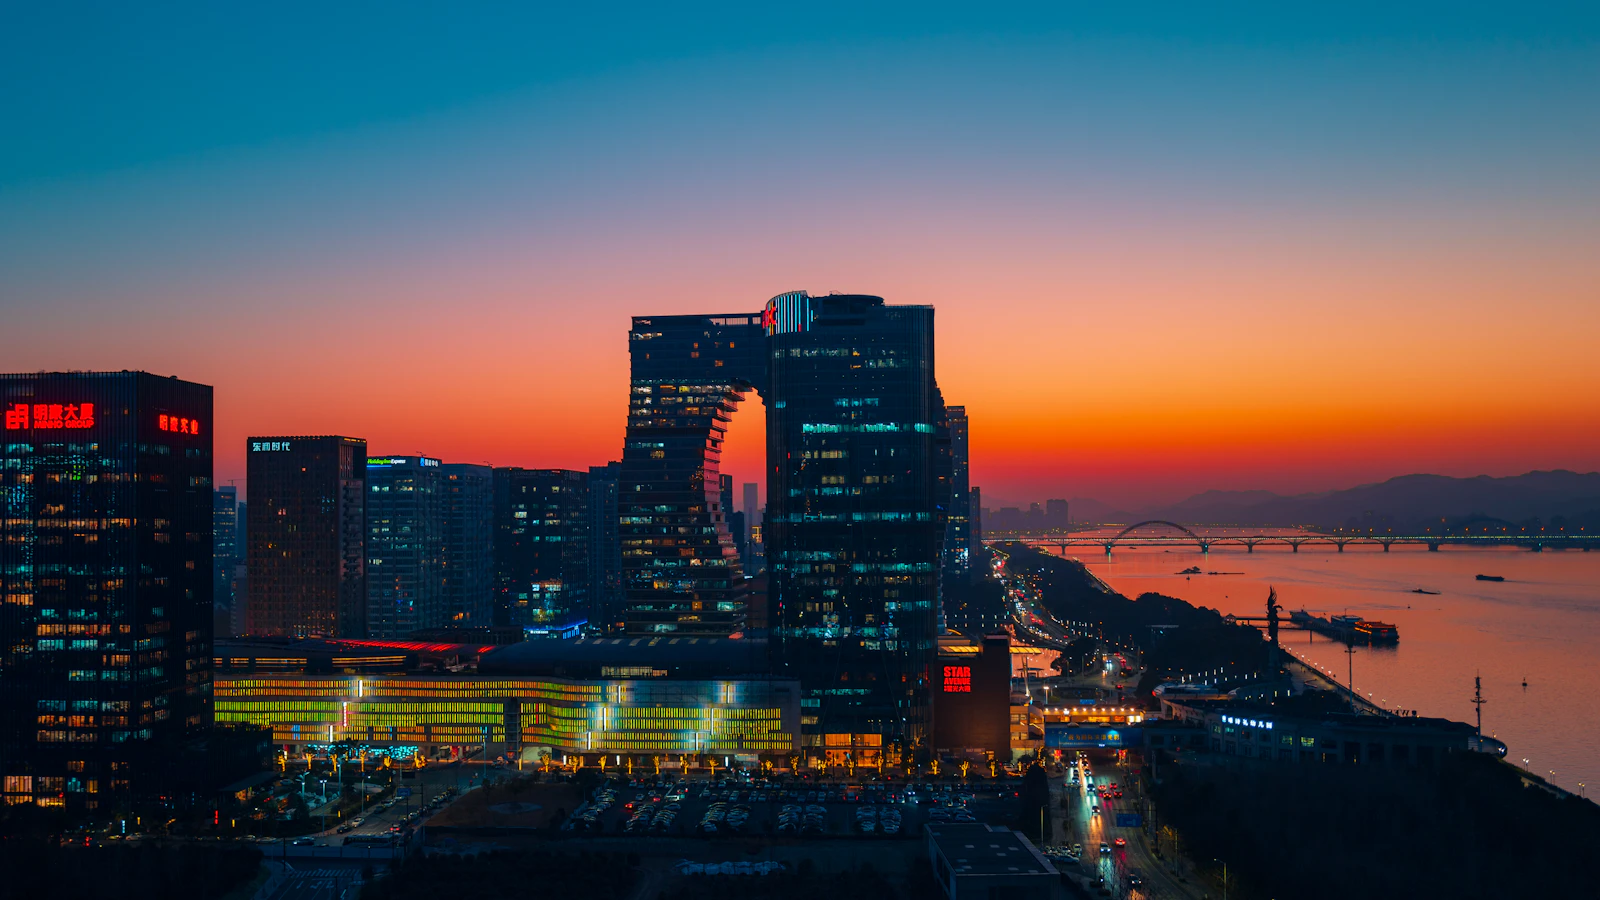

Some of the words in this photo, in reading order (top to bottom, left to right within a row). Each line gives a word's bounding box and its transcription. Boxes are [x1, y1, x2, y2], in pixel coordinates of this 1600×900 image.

[65, 420, 94, 429] GROUP
[944, 666, 971, 677] STAR
[944, 677, 971, 685] AVENUE
